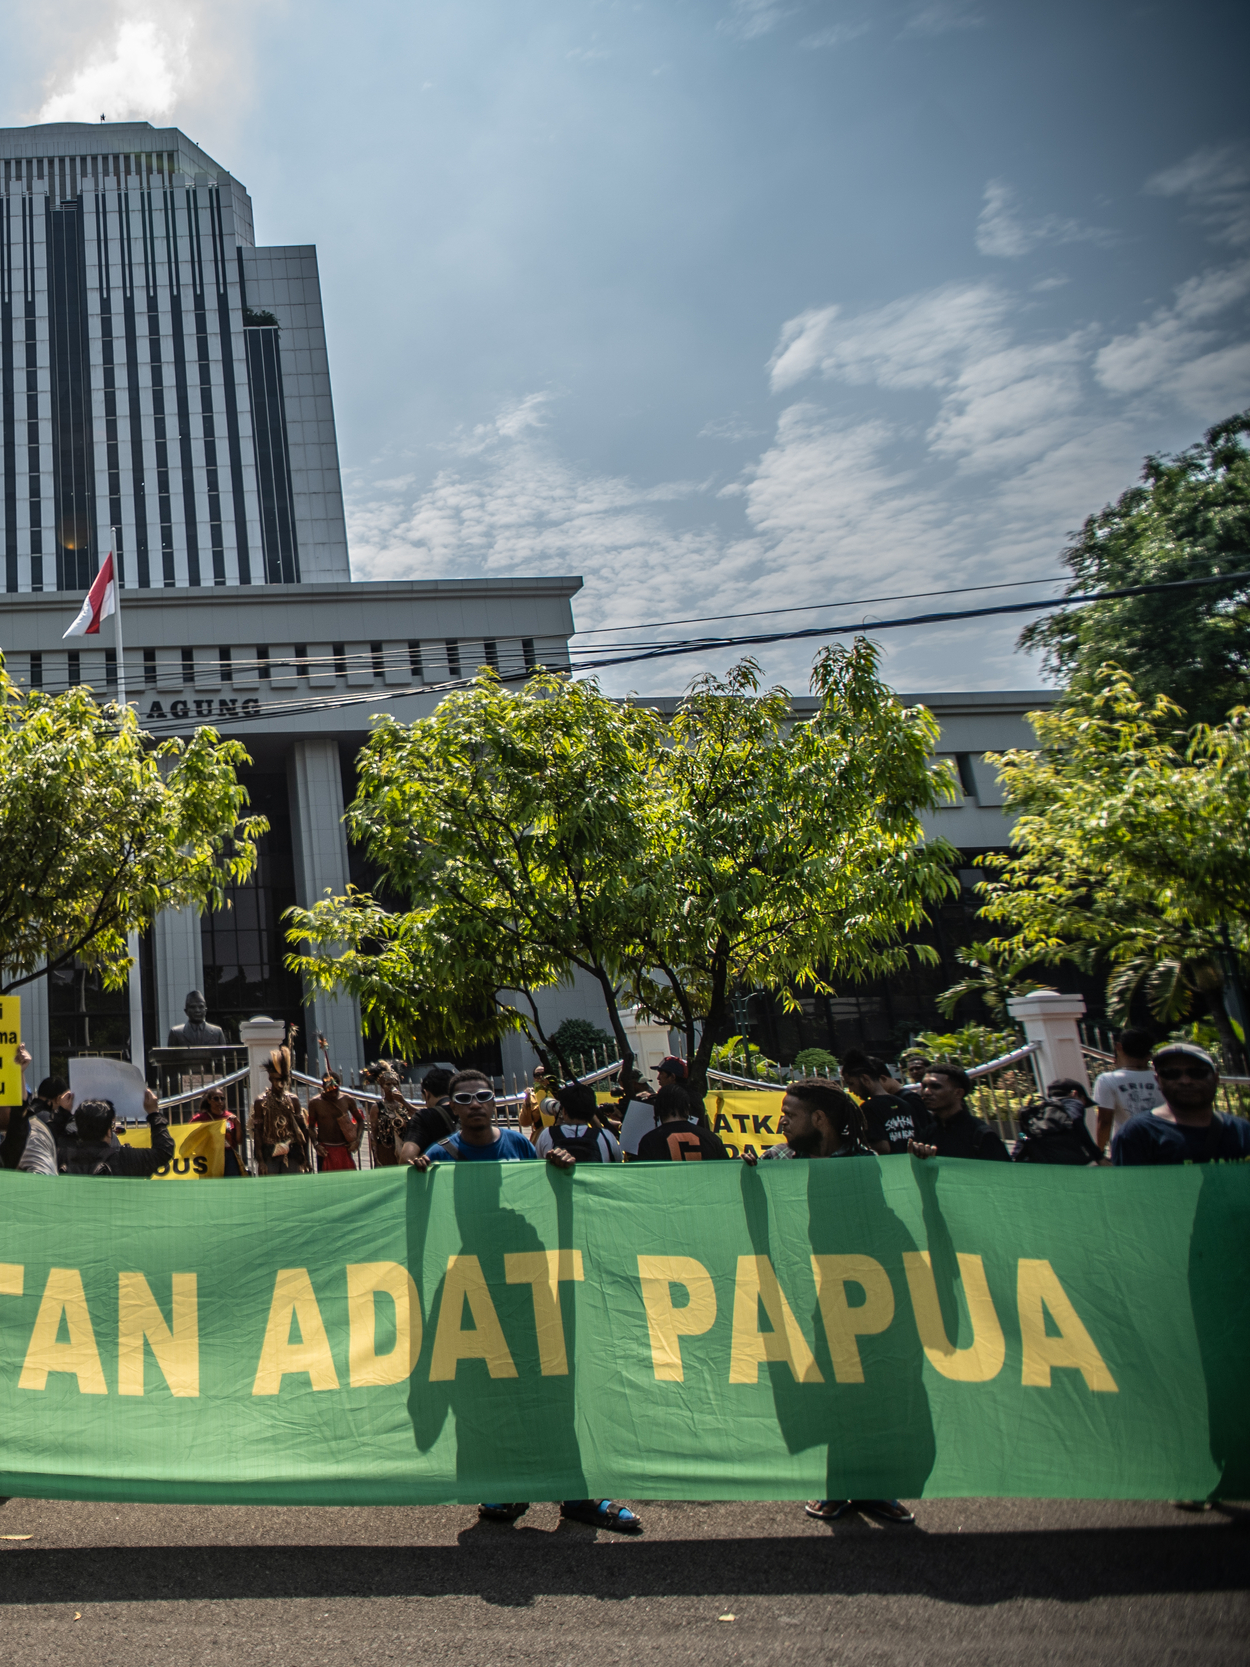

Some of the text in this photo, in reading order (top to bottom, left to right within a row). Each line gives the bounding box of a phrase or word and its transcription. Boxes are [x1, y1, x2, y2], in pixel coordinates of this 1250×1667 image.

[146, 698, 261, 718] AGUNG
[1118, 1082, 1162, 1092] ERIG
[252, 1249, 584, 1396] ADAT
[637, 1250, 1119, 1392] PAPUA
